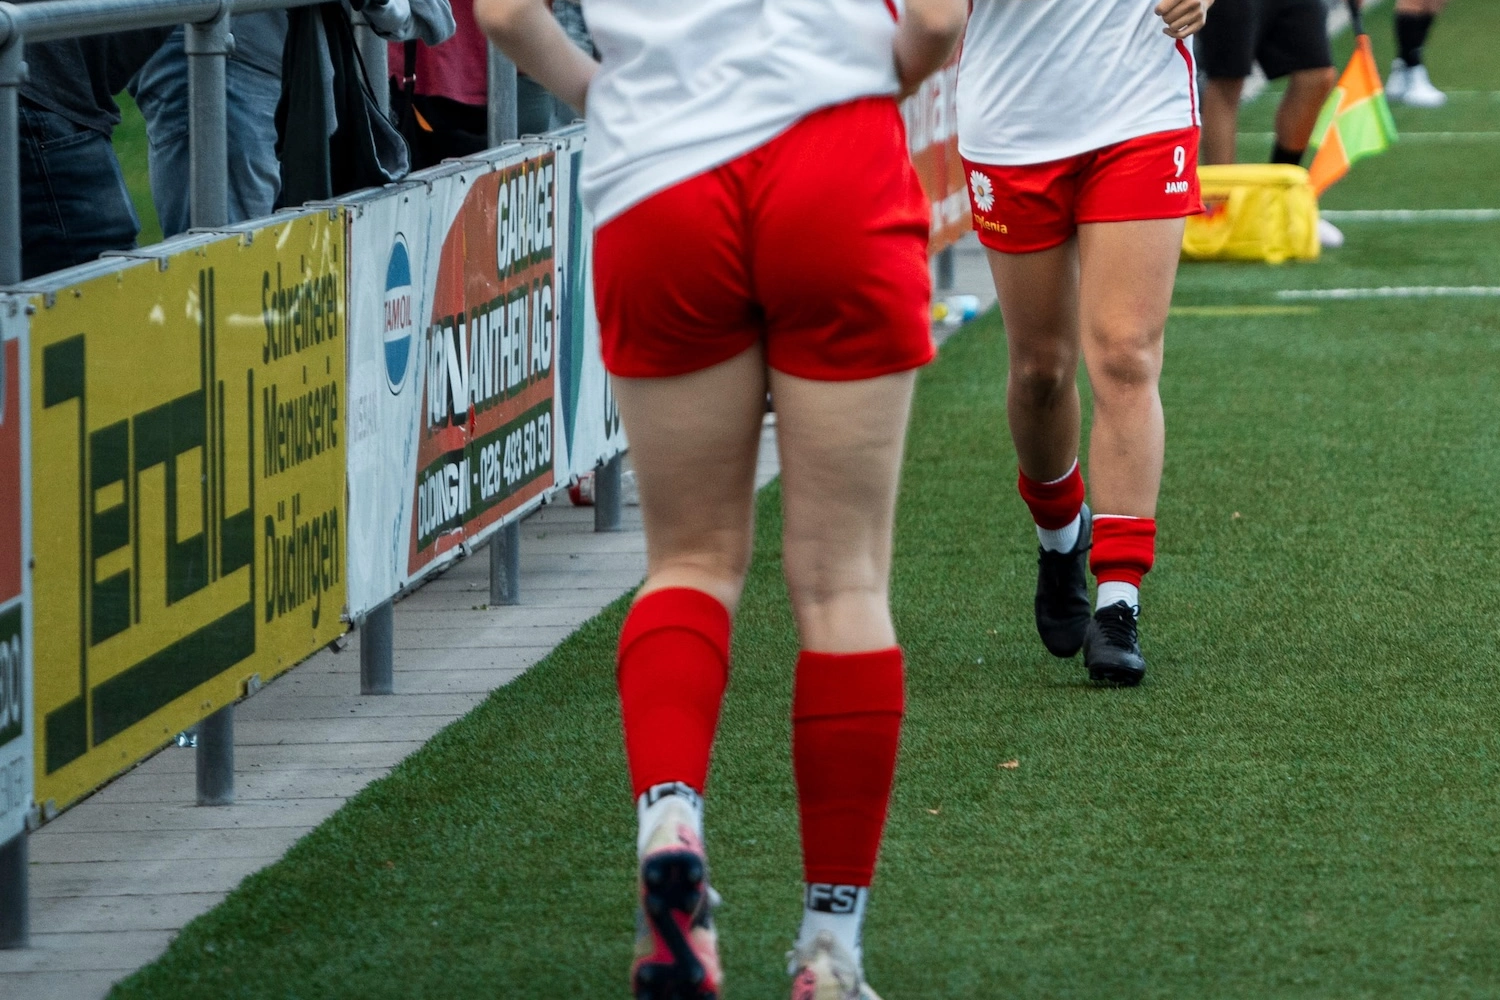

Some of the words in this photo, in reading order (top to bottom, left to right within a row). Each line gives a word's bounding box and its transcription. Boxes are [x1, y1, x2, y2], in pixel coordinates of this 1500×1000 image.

[1164, 180, 1189, 194] JAKO
[1173, 145, 1185, 178] 9
[497, 162, 553, 271] GARAGE
[262, 243, 338, 365] Schreinerei
[384, 294, 412, 335] TAMOIL
[530, 285, 552, 376] AG
[263, 356, 338, 479] Menuiserie
[479, 440, 501, 501] 026
[503, 428, 522, 486] 493
[524, 419, 536, 475] 50
[538, 411, 551, 467] 50
[264, 493, 339, 629] Düdingen
[810, 885, 856, 913] FS
